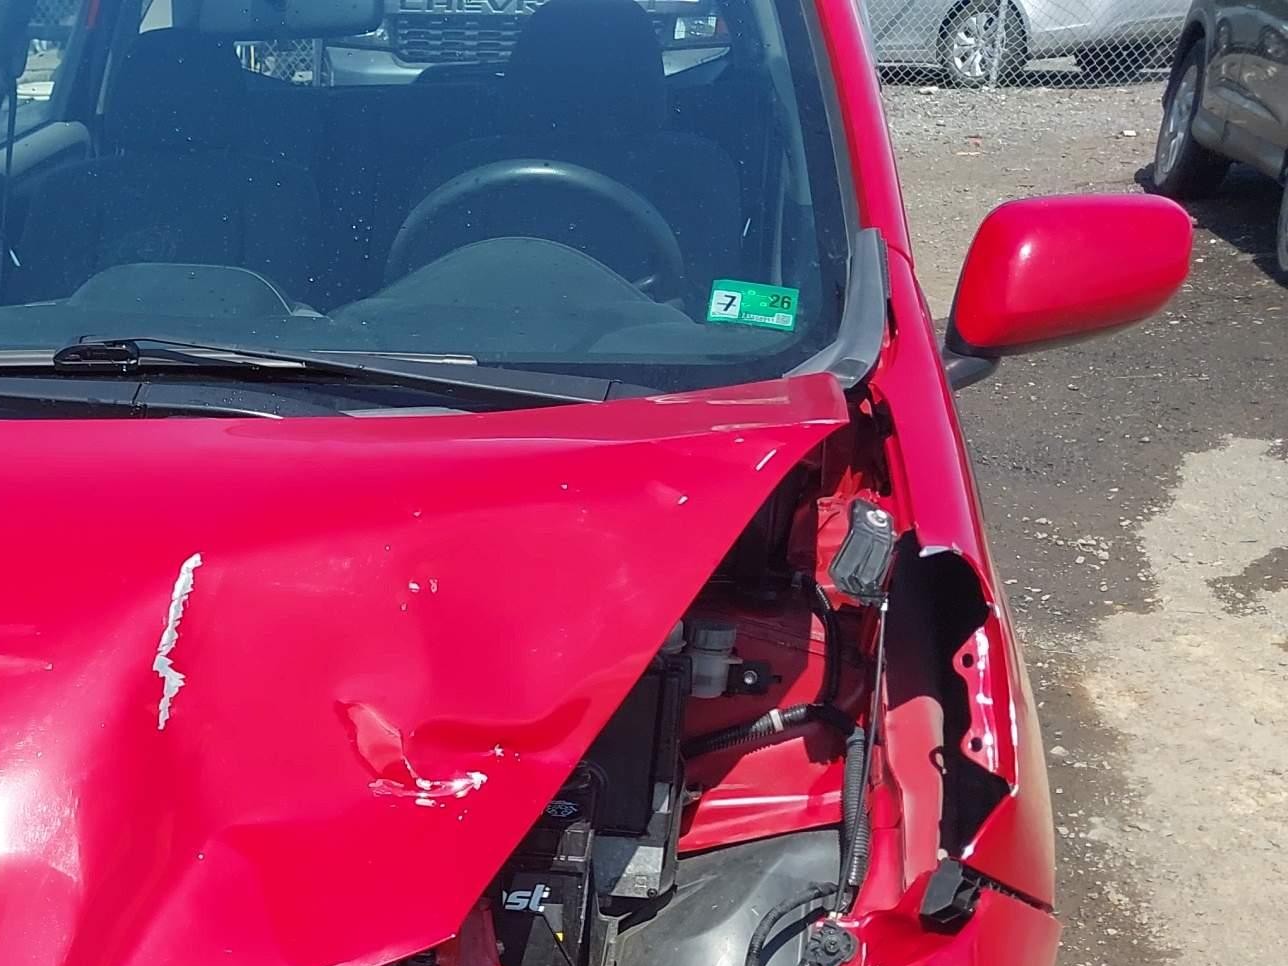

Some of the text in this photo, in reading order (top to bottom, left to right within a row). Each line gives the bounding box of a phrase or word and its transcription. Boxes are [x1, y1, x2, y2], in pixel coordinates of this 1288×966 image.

[716, 294, 792, 312] 7 26
[502, 884, 551, 912] st
